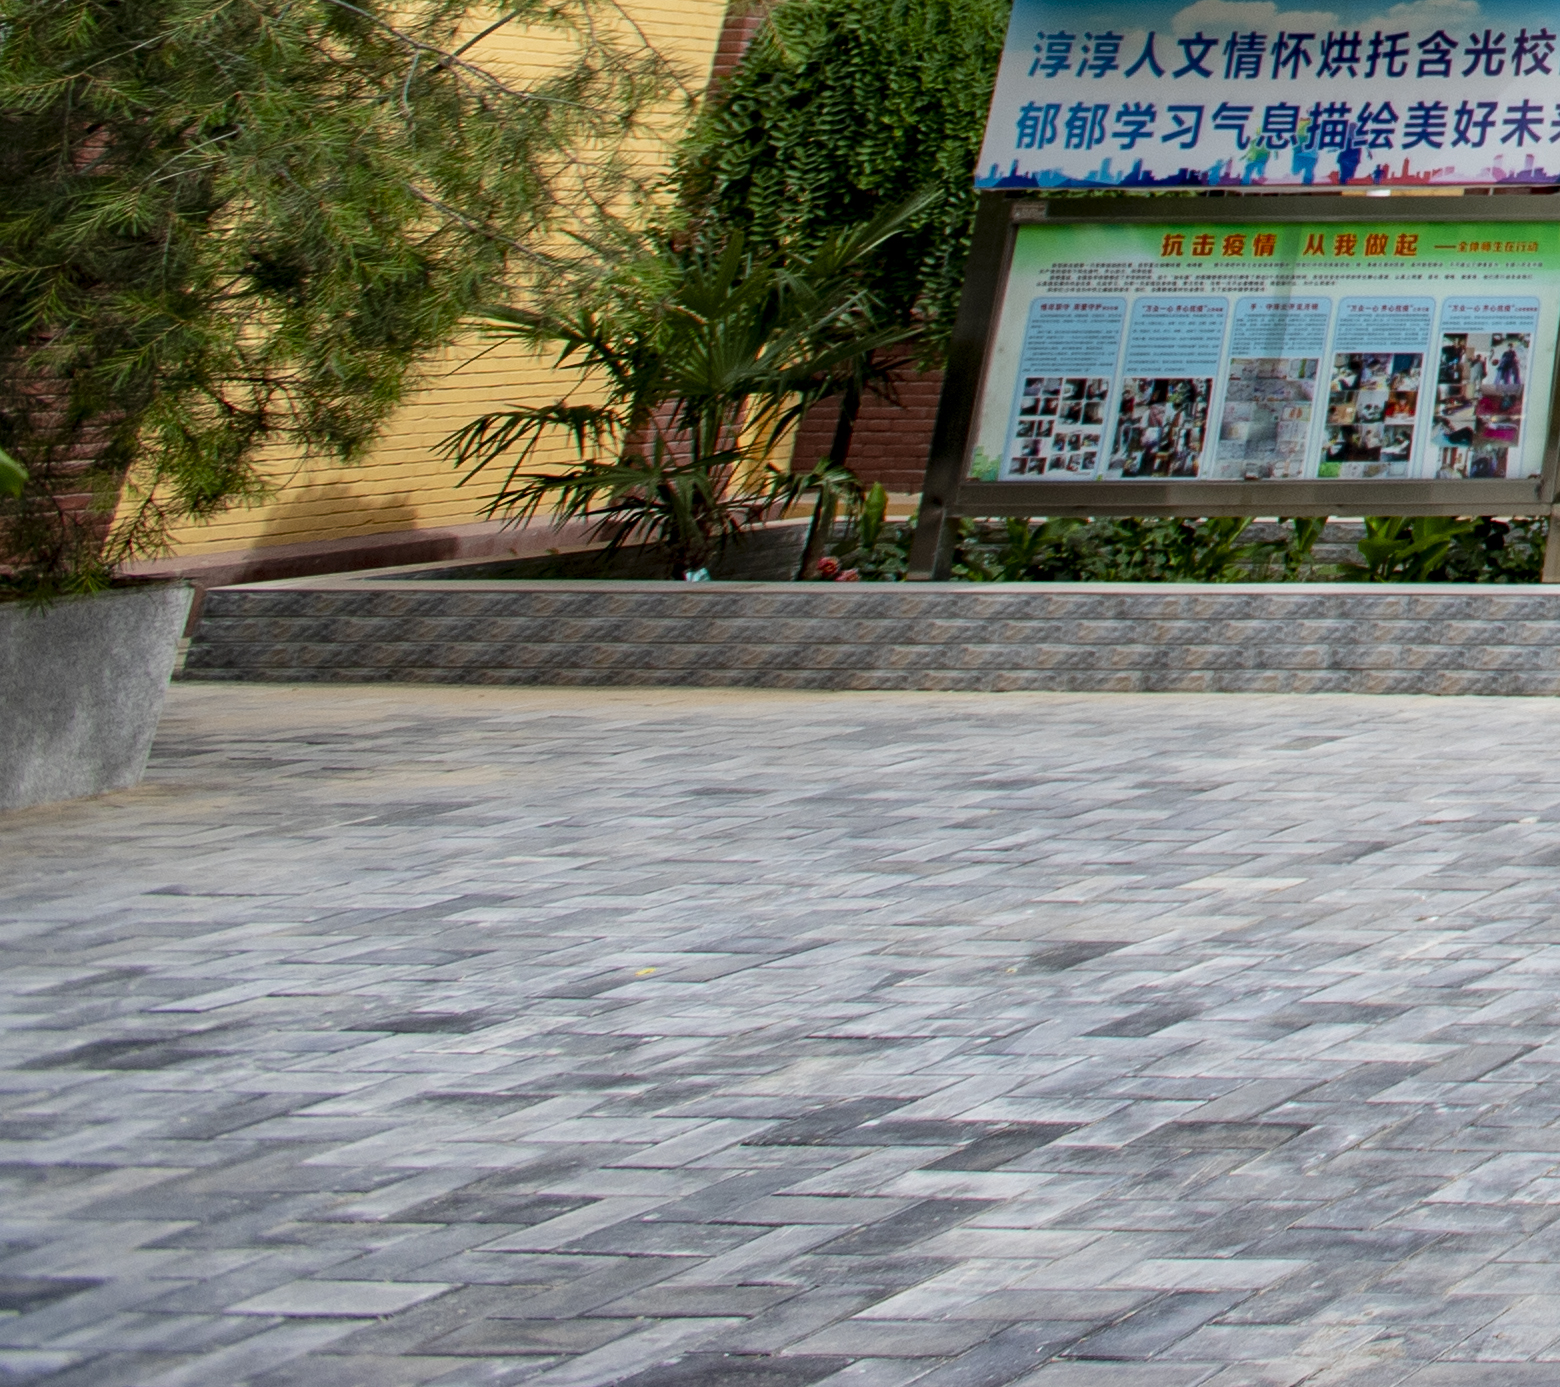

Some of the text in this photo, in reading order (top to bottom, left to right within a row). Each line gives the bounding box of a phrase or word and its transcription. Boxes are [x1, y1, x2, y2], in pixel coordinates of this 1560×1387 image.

[1160, 233, 1278, 257] 抗击疫情
[1303, 233, 1419, 257] 从我做起
